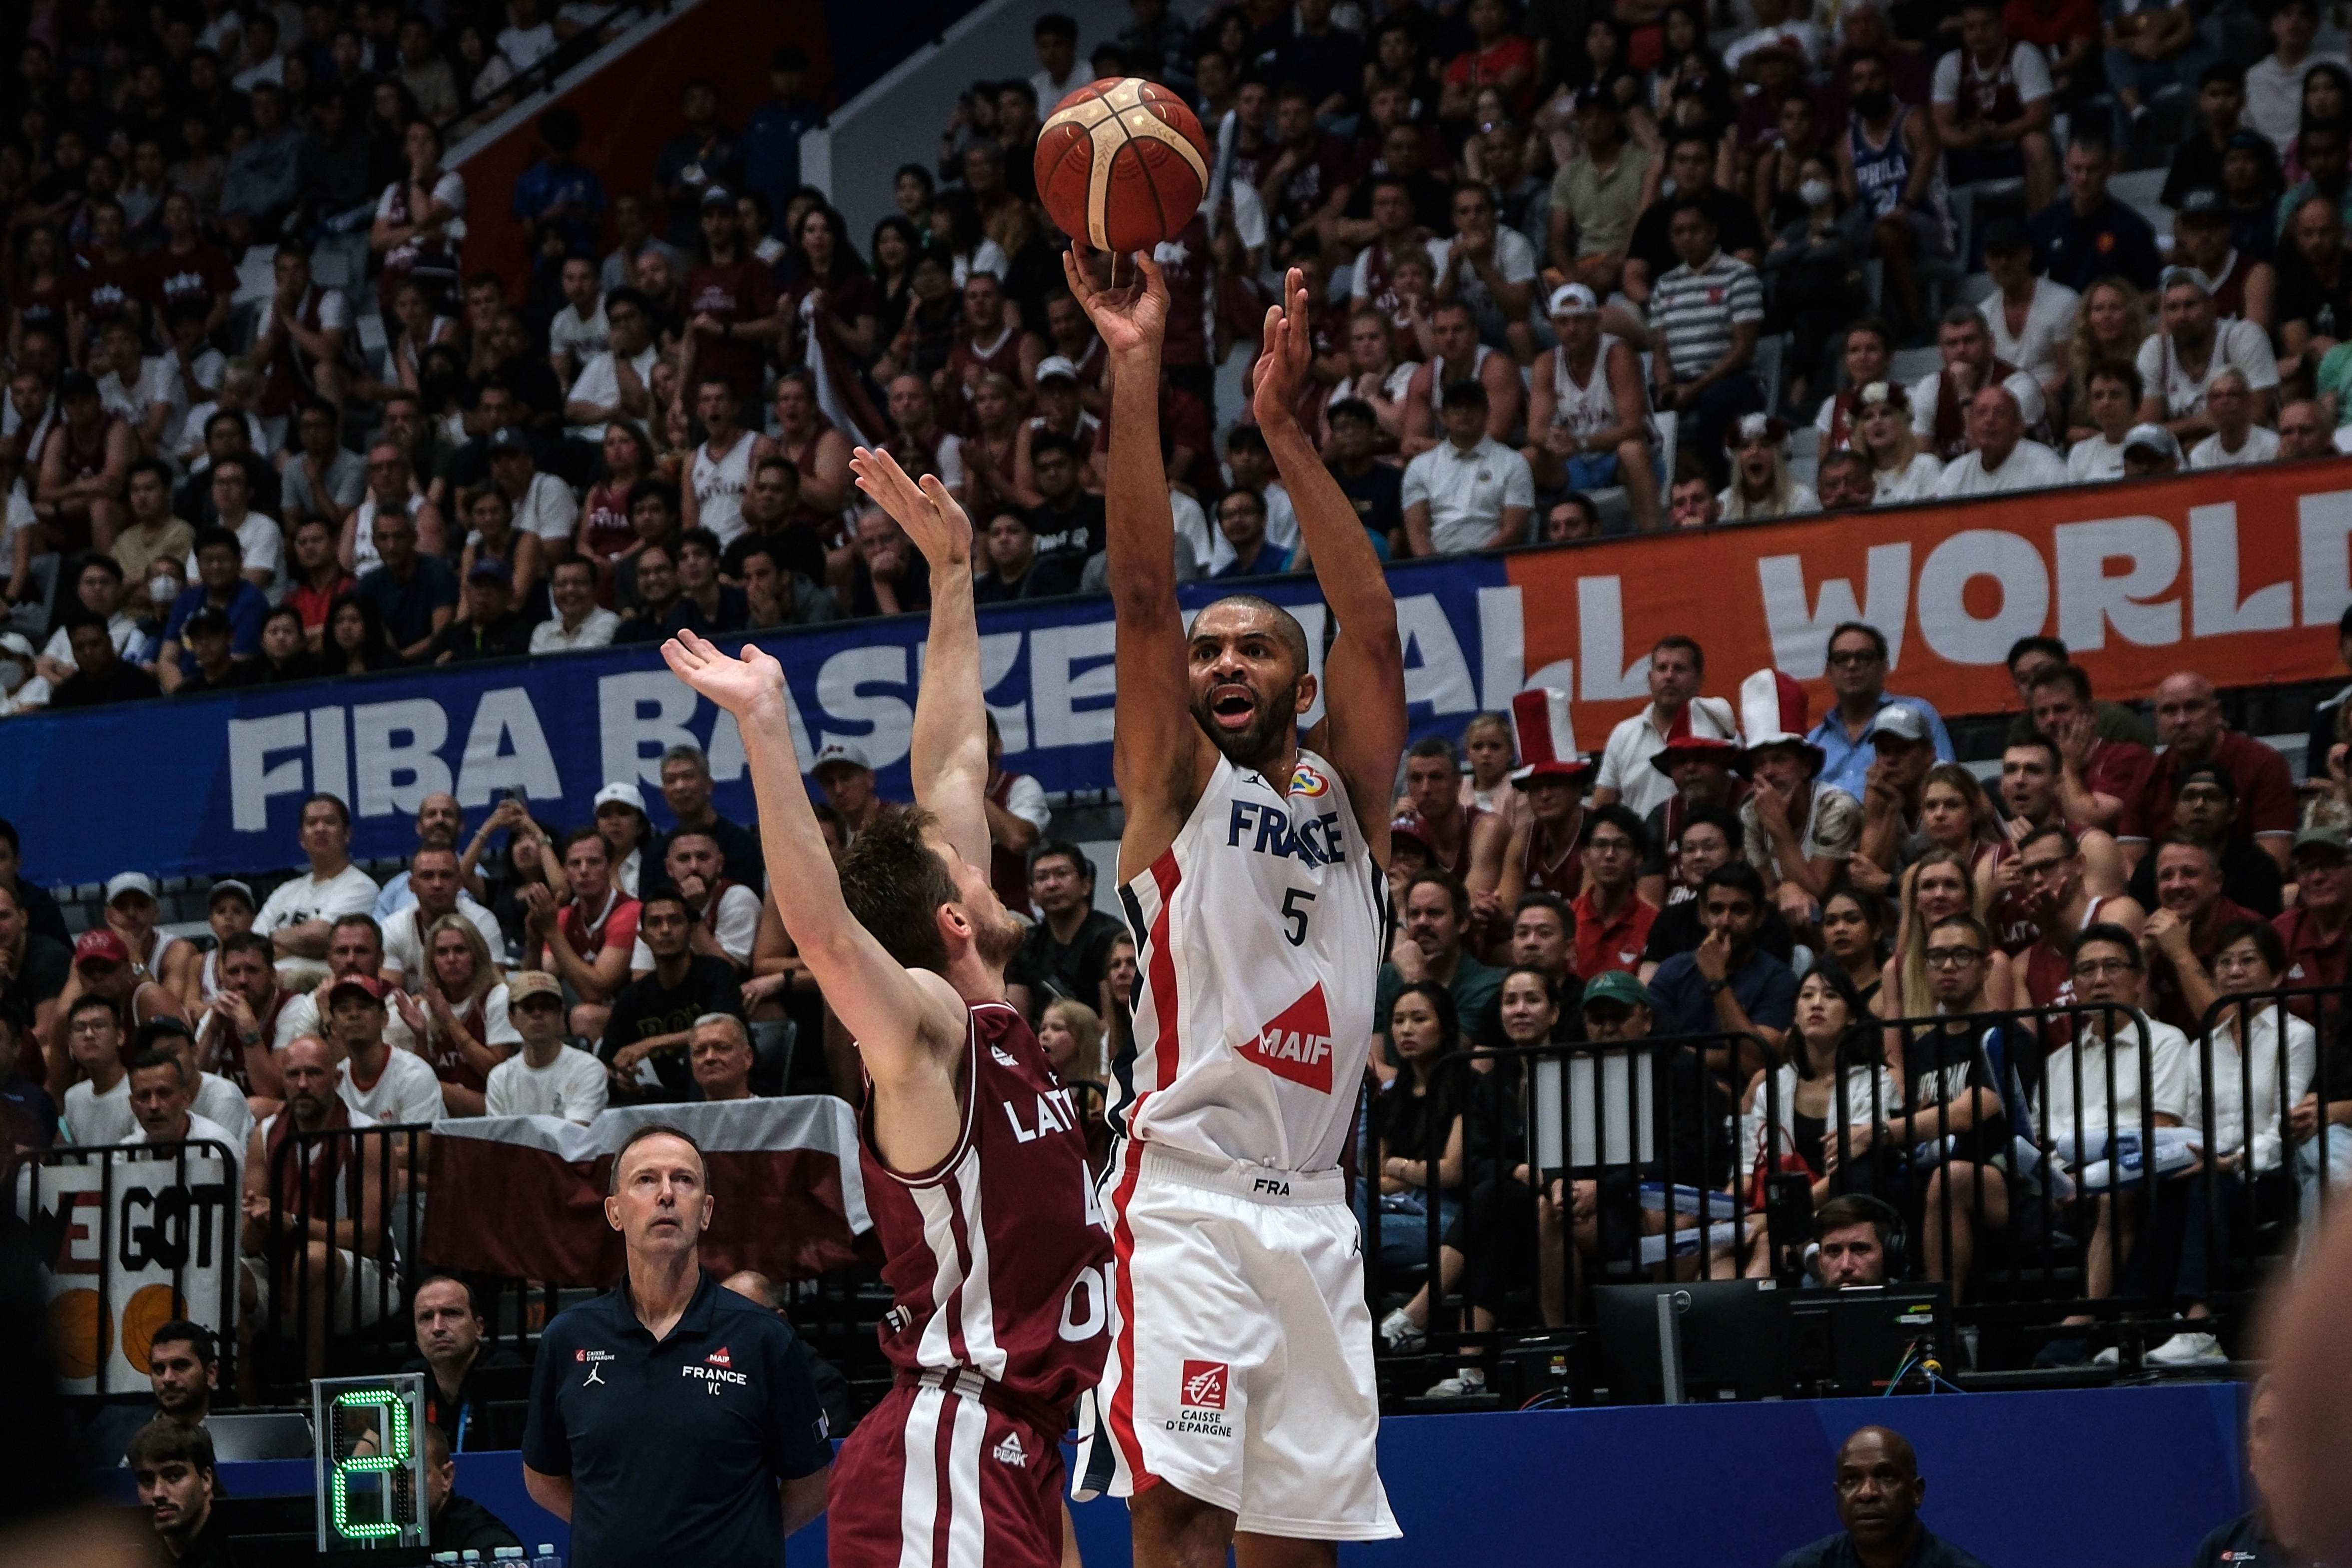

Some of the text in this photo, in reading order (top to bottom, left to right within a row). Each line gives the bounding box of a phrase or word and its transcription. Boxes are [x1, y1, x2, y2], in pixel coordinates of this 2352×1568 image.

[228, 686, 564, 832] FIBA
[1282, 887, 1316, 946] 5
[1258, 1027, 1332, 1065] MAIF
[1253, 1178, 1289, 1196] FRA
[120, 1184, 228, 1271] GOT
[709, 1354, 729, 1363] MAIF
[682, 1365, 747, 1386] FRANCE
[707, 1381, 720, 1396] VC
[1181, 1410, 1220, 1423] CAISSE
[1166, 1421, 1231, 1437] D'EPARGNE
[332, 1390, 409, 1538] 2
[993, 1445, 1029, 1468] PEAK
